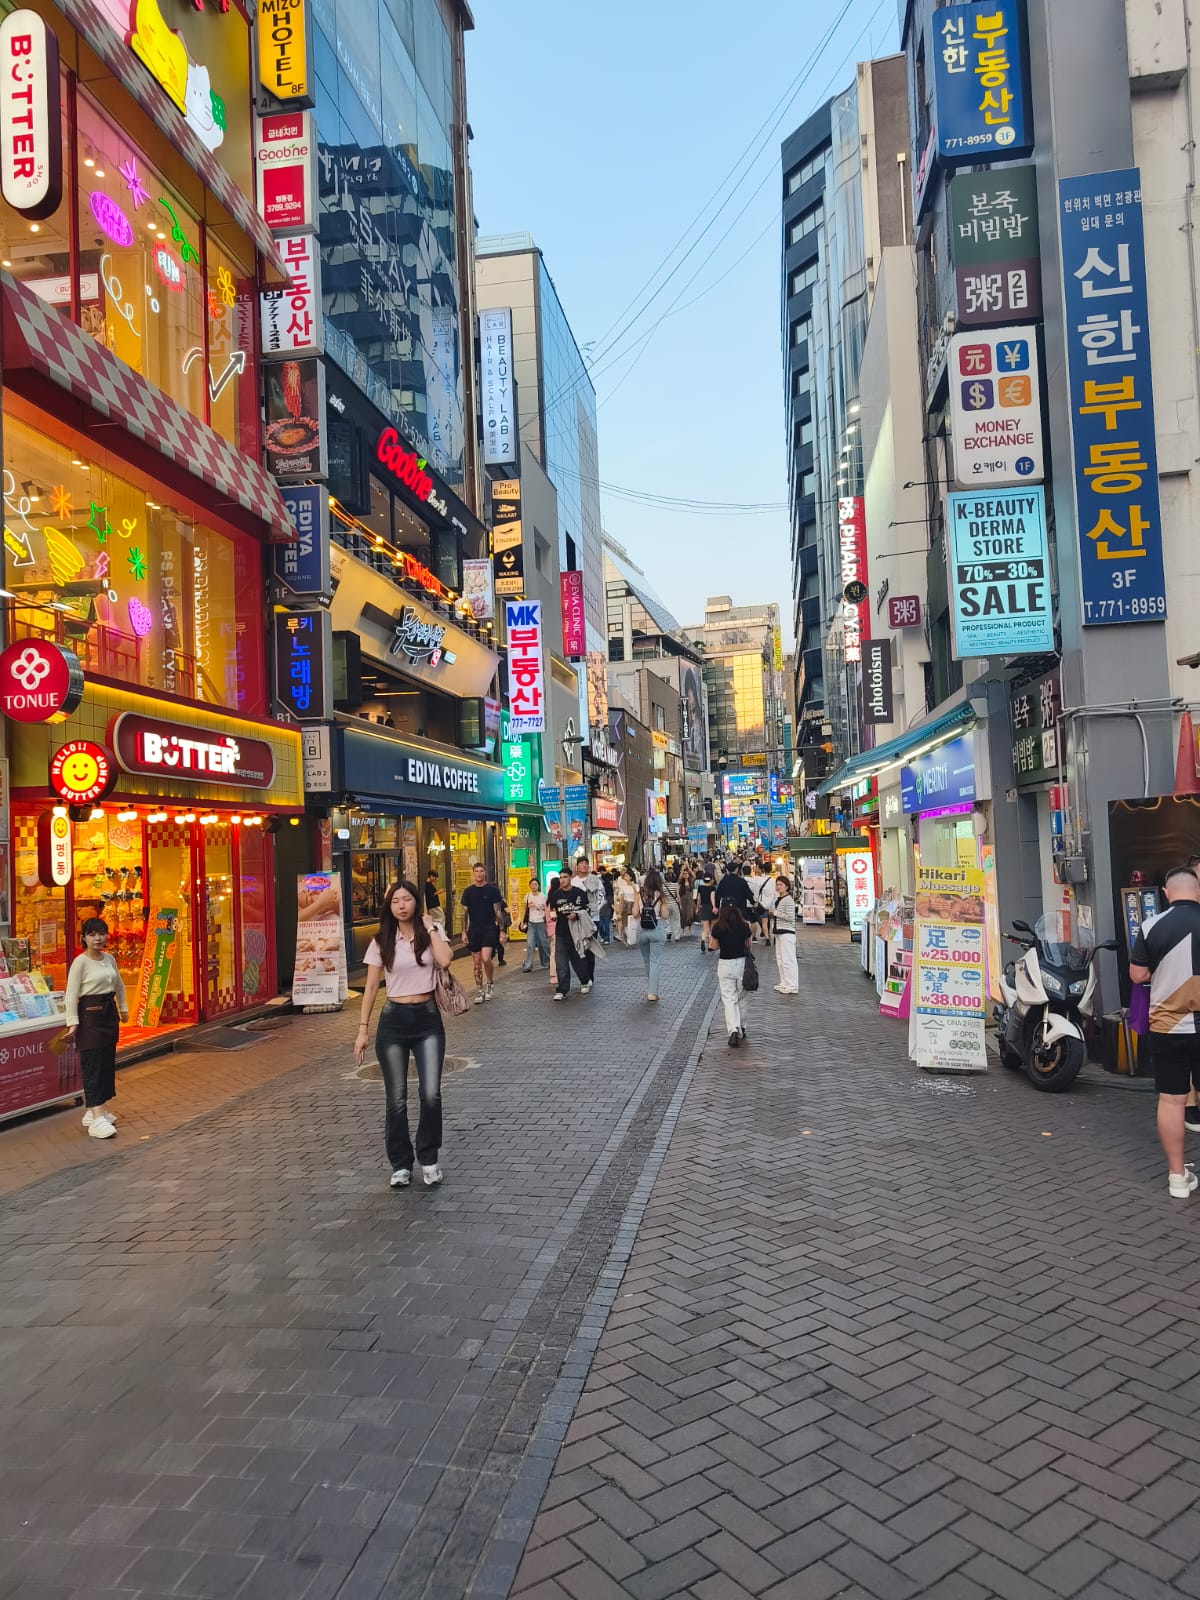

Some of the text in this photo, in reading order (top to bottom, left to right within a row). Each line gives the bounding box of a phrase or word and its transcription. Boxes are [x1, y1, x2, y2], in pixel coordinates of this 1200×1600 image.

[272, 12, 293, 87] HOTEL
[941, 16, 968, 74] 신한
[972, 11, 1014, 125] 부동산
[944, 133, 993, 149] 771-8959
[26, 164, 44, 189] SHOP
[967, 190, 1019, 216] 본죽
[1115, 189, 1142, 205] 전광판
[958, 214, 1029, 243] 비빔밥
[1080, 212, 1124, 231] 임대 문의
[285, 238, 313, 347] 부동산
[963, 274, 1003, 313] 粥
[1011, 273, 1024, 306] 2F
[965, 349, 985, 371] 元
[1003, 344, 1021, 368] ¥
[497, 335, 510, 454] BEAUTY LAB 2
[969, 382, 986, 408] $
[1005, 379, 1025, 404] €
[975, 419, 1021, 434] MONEY
[964, 433, 1034, 450] EXCHANGE
[972, 461, 1007, 474] 오케이
[1019, 461, 1031, 471] 1F
[493, 488, 519, 496] Beauty
[957, 498, 1035, 519] K-BEAUTY
[284, 500, 297, 574] CFEE
[299, 500, 313, 557] EDIYA
[969, 518, 1026, 537] DERMA
[973, 538, 1024, 556] STORE
[1111, 569, 1137, 589] 3F
[274, 588, 288, 599] 1F
[959, 583, 1046, 617] SALE
[507, 606, 539, 626] MK
[892, 600, 917, 624] 粥
[1085, 596, 1165, 618] T.771-8959
[286, 616, 313, 633] 루키
[572, 607, 581, 636] CLINIC
[962, 620, 1045, 632] PROFESSIONAL PRODUCT
[290, 636, 312, 710] 노래방
[510, 627, 543, 717] 부동산
[868, 647, 888, 717] photoism
[4, 692, 59, 710] TONUE
[1014, 695, 1030, 729] 본죽
[1040, 680, 1054, 728] 粥
[511, 716, 543, 729] 777-7727
[1012, 736, 1035, 773] 비빔밥
[96, 755, 108, 784] SHOP
[408, 758, 478, 793] EDIYA COFFEE
[60, 785, 101, 801] BUTTER
[919, 868, 965, 881] Hikari
[920, 880, 980, 894] Massage
[926, 929, 948, 949] 足
[924, 970, 949, 982] 全身
[136, 958, 154, 1028] COOKIE TIME
[960, 1031, 978, 1039] OPEN
[12, 1041, 45, 1059] TONUE
